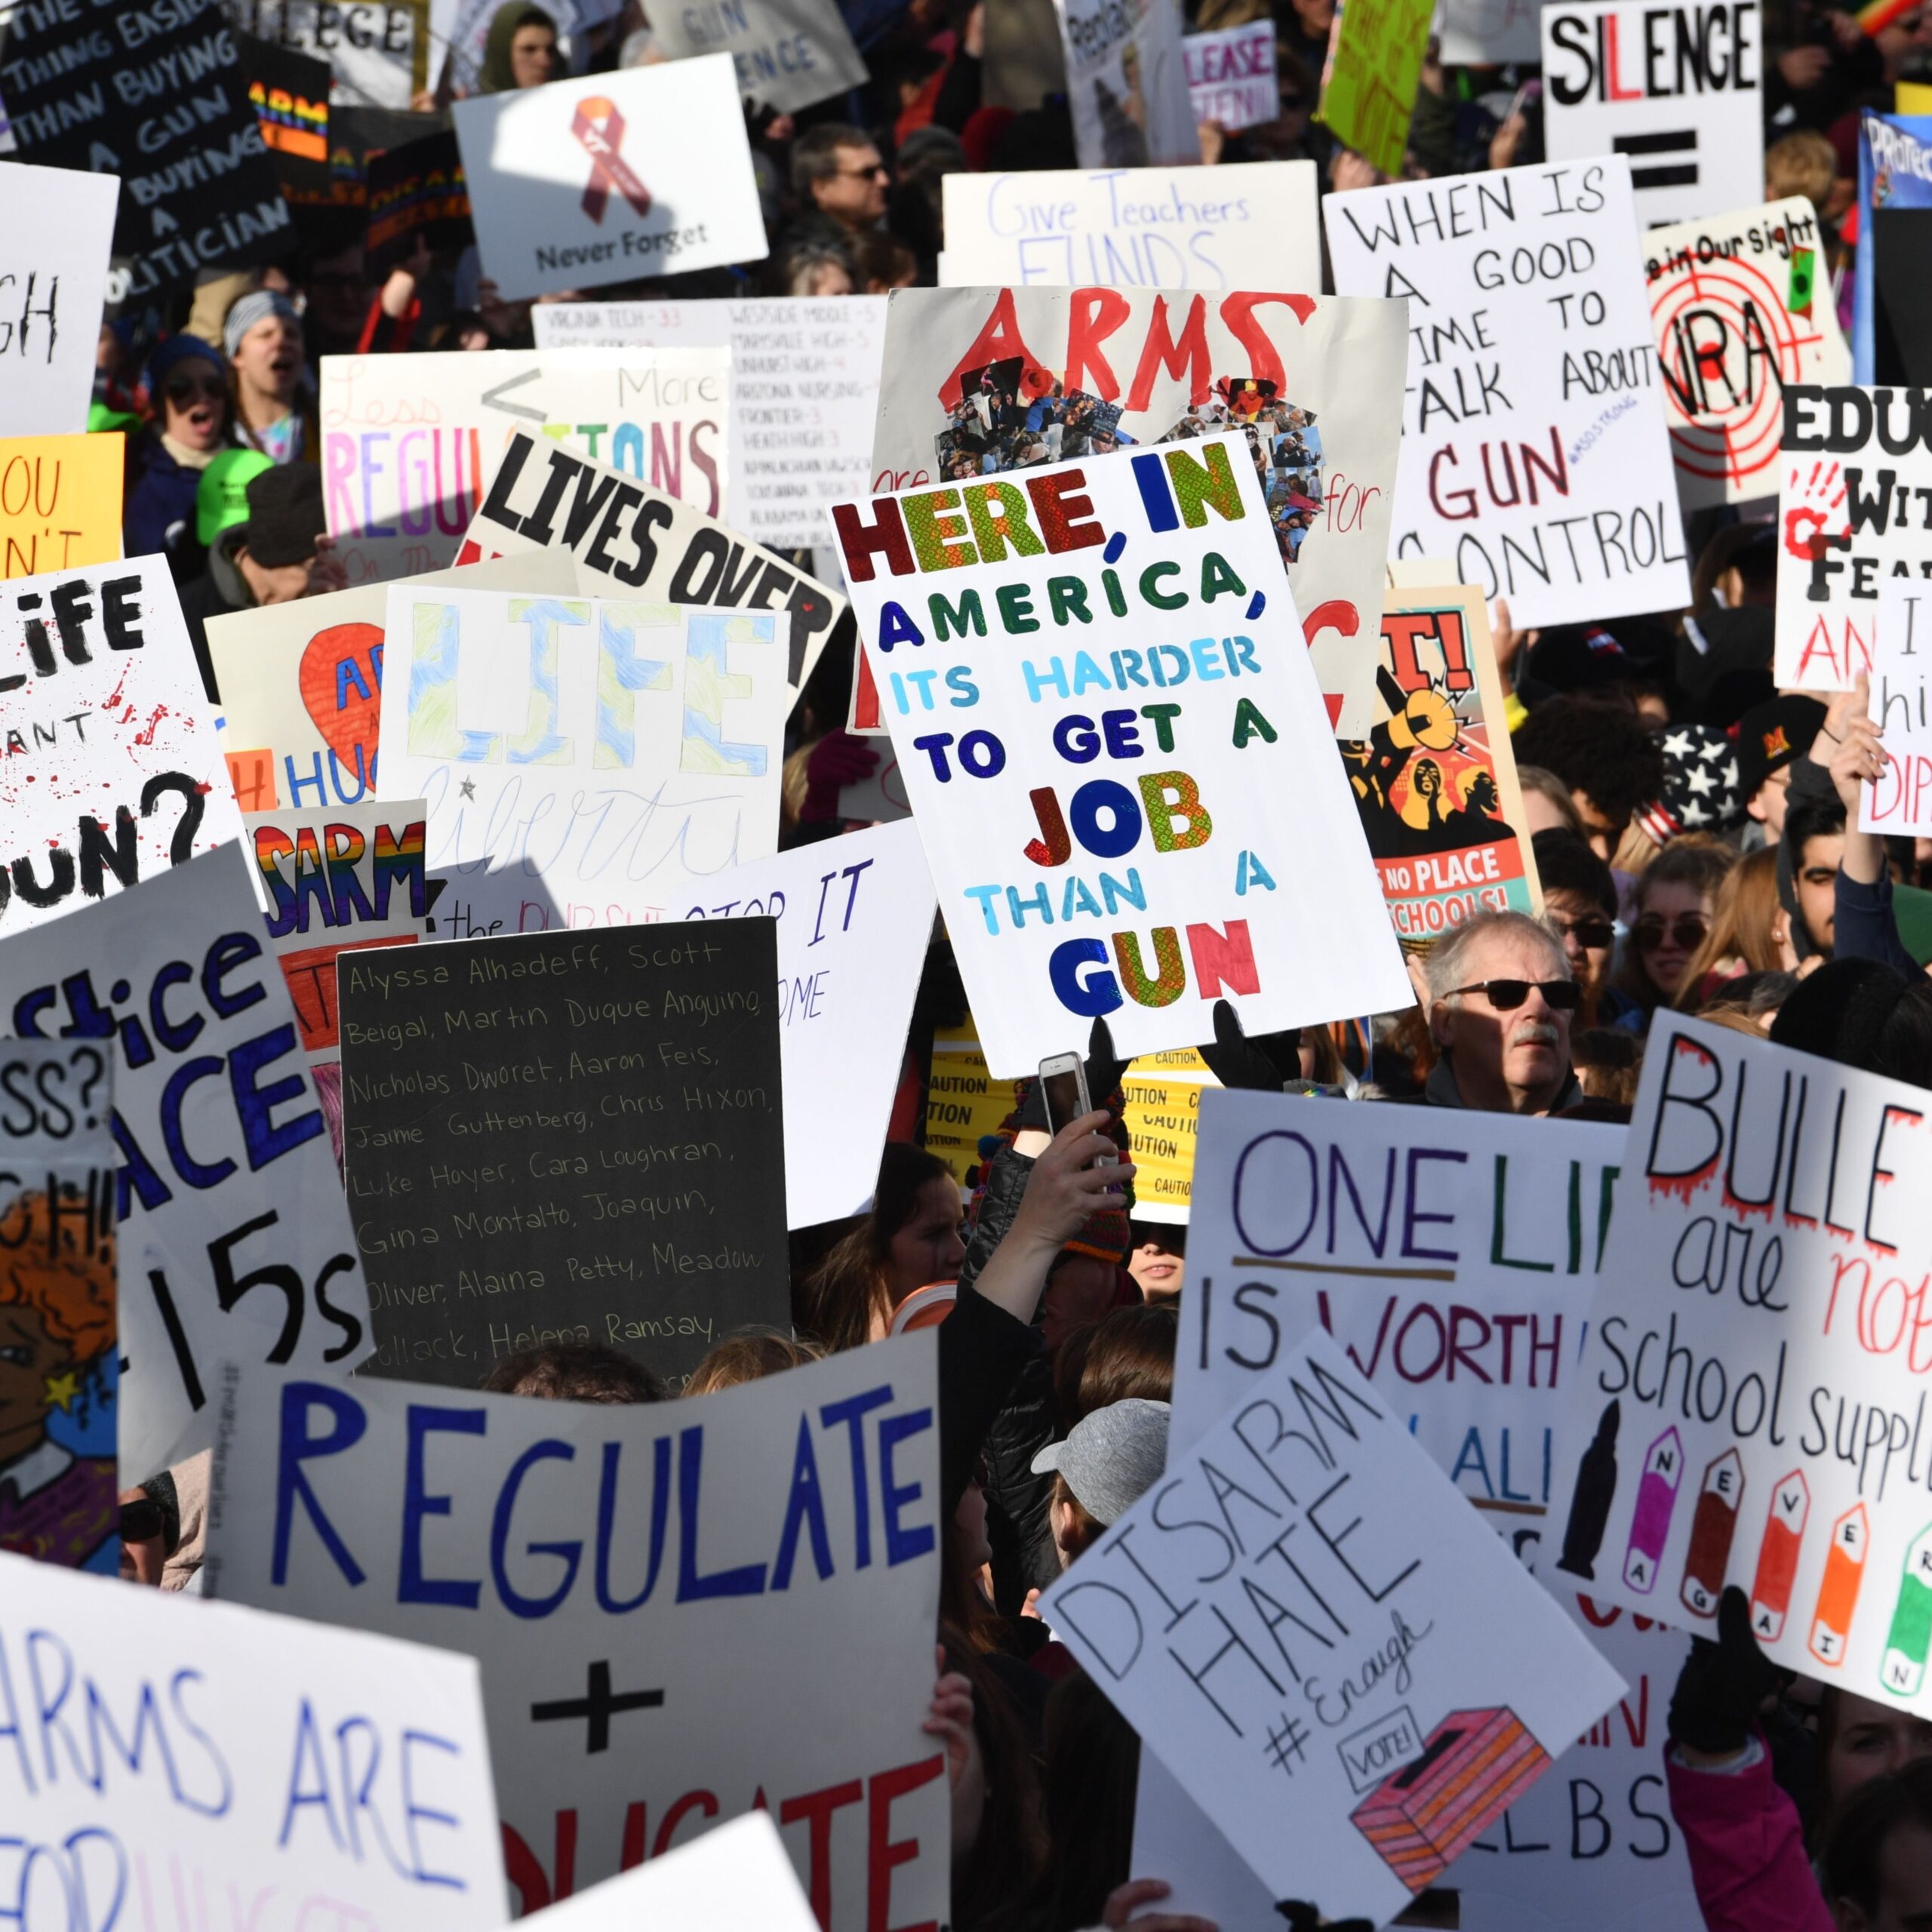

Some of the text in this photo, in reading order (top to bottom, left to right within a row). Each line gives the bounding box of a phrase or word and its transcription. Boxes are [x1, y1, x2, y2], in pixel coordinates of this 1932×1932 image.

[11, 0, 82, 40] THE
[1549, 2, 1758, 106] SILENCE
[2, 29, 112, 91] THING
[11, 82, 106, 145] THAN
[89, 85, 230, 173] A GUN
[152, 209, 179, 238] A
[988, 171, 1251, 238] Give Teachers
[1342, 165, 1605, 253] WHEN IS
[536, 223, 708, 272] Never Forget
[1386, 237, 1595, 307] A GOOD
[1665, 246, 1694, 274] in
[1697, 235, 1744, 265] Our
[1548, 291, 1606, 331] TO
[937, 286, 1318, 414] ARMS
[1657, 300, 1786, 416] NRA
[325, 359, 719, 426] Less More
[1402, 343, 1655, 435] ALK ABOUT
[1780, 385, 1932, 457] EDU
[1131, 441, 1247, 534] IN
[1323, 472, 1381, 534] for
[1428, 426, 1570, 521] GUN
[480, 432, 674, 588] LIVES
[669, 527, 833, 688] OVER
[1900, 597, 1922, 656] I
[408, 598, 768, 777] LIFE
[889, 665, 980, 715] ITS
[1021, 635, 1262, 703] HARDER
[913, 697, 1278, 783] TO GET A
[1023, 770, 1214, 868] JOB
[807, 857, 875, 948] IT
[963, 850, 1277, 937] THAN A
[1385, 866, 1411, 891] NO
[1414, 846, 1500, 893] PLACE
[444, 900, 504, 939] the
[349, 965, 450, 1000] Alyssa
[628, 943, 722, 969] Scott
[1049, 918, 1261, 1018] GUN
[344, 1016, 435, 1051] Beigal,
[445, 1004, 549, 1035] Martin
[564, 995, 651, 1027] Duque
[1155, 1051, 1197, 1065] CAUTION
[349, 1069, 451, 1103] Nicholas
[569, 1051, 645, 1080] Aaron
[657, 1041, 719, 1067] Feis,
[349, 1125, 425, 1149] Jaime
[601, 1092, 665, 1118] Chris
[351, 1174, 414, 1198] Luke
[430, 1162, 515, 1192] Hoyer,
[529, 1151, 589, 1179] Cara
[1232, 1129, 1469, 1260] ONE
[356, 1220, 440, 1255] Gina
[452, 1206, 577, 1241] Montalto,
[1671, 1215, 1789, 1312] are
[458, 1269, 546, 1298] Alaina
[566, 1254, 644, 1282] Petty,
[652, 1241, 765, 1275] Meadow
[367, 1328, 478, 1369] ollack,
[1198, 1276, 1564, 1390] IS WORTH
[269, 1380, 937, 1622] REGULATE
[1053, 1356, 1385, 1682] DISARM
[1166, 1473, 1423, 1740] HATE
[1346, 1730, 1414, 1779] VOTE!
[278, 1693, 468, 1896] ARE
